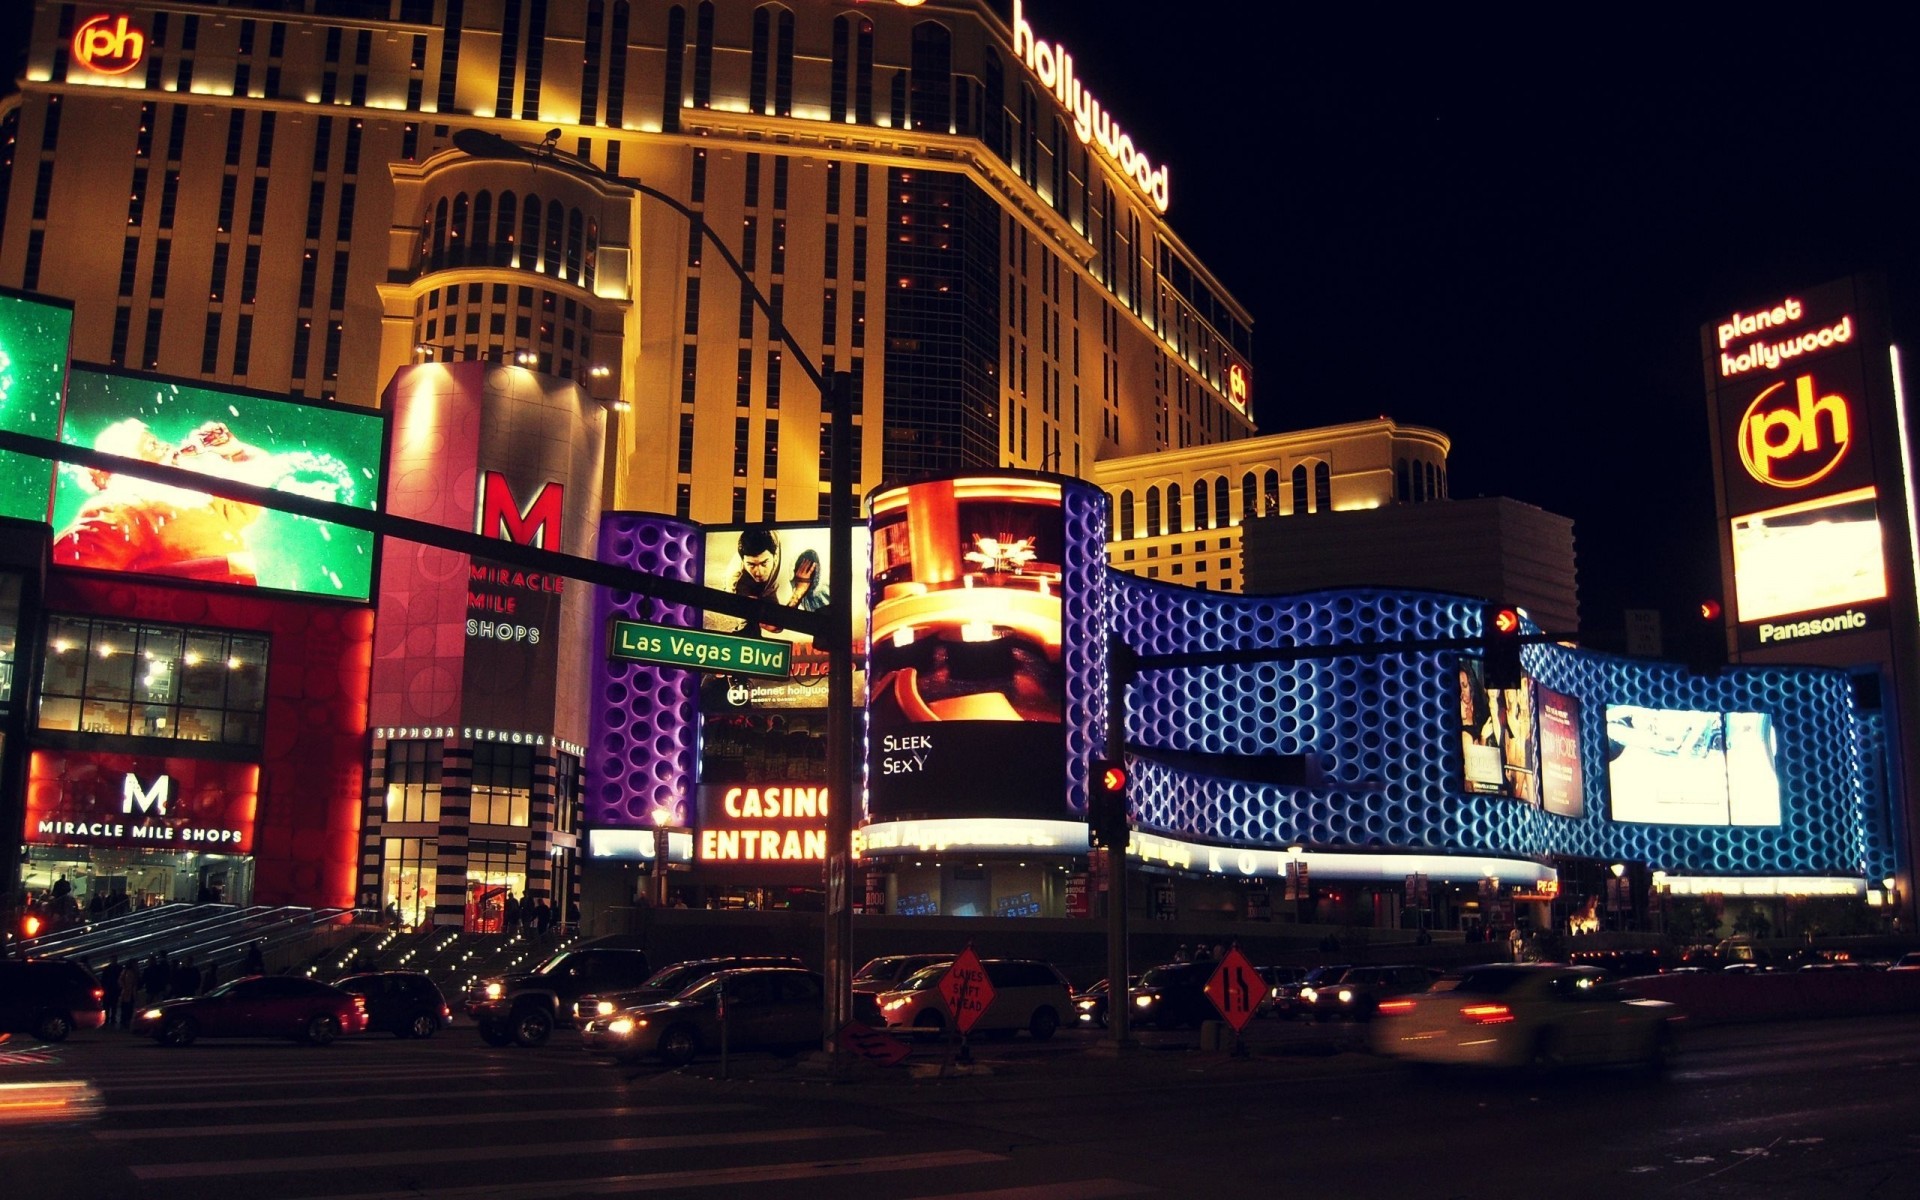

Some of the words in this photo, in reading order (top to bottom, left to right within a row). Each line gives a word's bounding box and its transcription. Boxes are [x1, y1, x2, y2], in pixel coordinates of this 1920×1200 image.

[81, 15, 144, 66] ph
[1013, 0, 1169, 212] hollywood
[1718, 298, 1802, 350] planet
[1720, 316, 1852, 376] hollywood
[1748, 374, 1850, 480] ph
[483, 470, 564, 553] M
[470, 564, 564, 595] MIRACLE
[468, 591, 518, 614] MILE
[466, 618, 541, 645] SHOPS
[1759, 610, 1867, 643] Panasonic
[622, 630, 662, 653] Las
[670, 637, 731, 664] Vegas
[740, 645, 783, 669] Blvd
[751, 686, 785, 698] planet
[787, 686, 830, 697] hollywo
[376, 726, 455, 740] SEPHORA
[464, 727, 546, 746] SEPHORA
[122, 771, 170, 816] M
[38, 820, 125, 838] MIRACLE
[132, 825, 175, 840] MILE
[182, 827, 243, 844] SHOPS
[702, 829, 861, 860] ENTRANE
[953, 968, 983, 983] LANES
[949, 996, 983, 1012] AEAD
